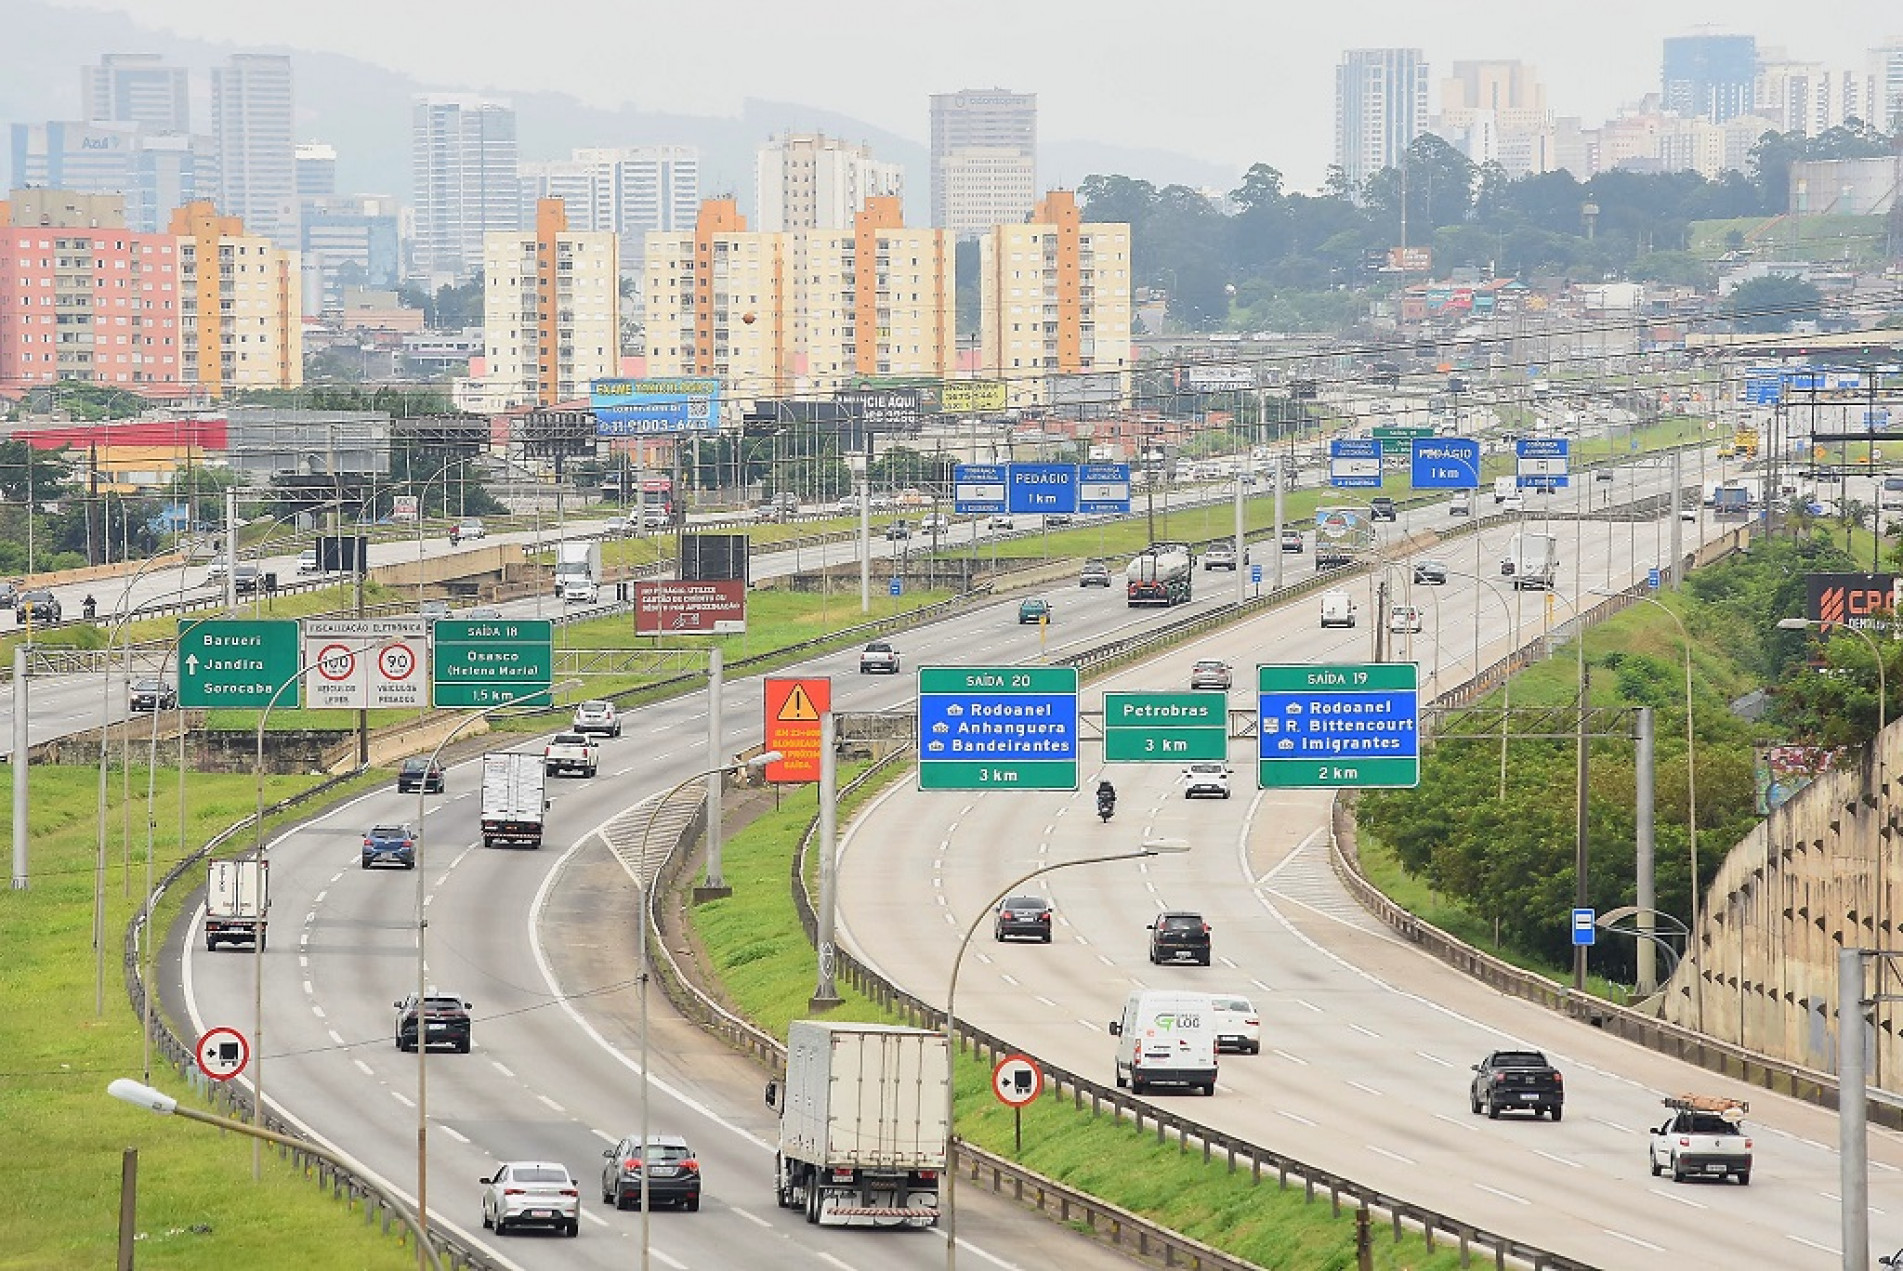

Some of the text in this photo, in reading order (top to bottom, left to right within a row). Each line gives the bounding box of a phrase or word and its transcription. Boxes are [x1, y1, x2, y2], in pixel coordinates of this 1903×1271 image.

[81, 136, 109, 149] Azul
[888, 395, 915, 408] AQUI
[1419, 444, 1473, 460] PEDÁGIO
[1015, 469, 1068, 484] PEDÁGIO
[1438, 468, 1460, 479] km
[1036, 493, 1057, 504] km
[310, 623, 421, 633] FISCALIZAÇÃO ELETRÔNICA
[467, 623, 518, 637] SAÍDA 18
[203, 635, 261, 646] Barueri
[387, 654, 408, 668] 90
[467, 650, 520, 662] Osasco
[203, 659, 264, 670] Jandira
[447, 665, 538, 676] (Helena Maria)
[966, 672, 1030, 687] SAÍDA 20
[1307, 670, 1368, 685] SAÍDA 19
[203, 683, 273, 694] Sorocaba
[376, 683, 417, 692] VEÍCULOS
[491, 690, 514, 701] km
[971, 703, 1051, 716] Rodoanel
[1123, 703, 1209, 717] Petrobras
[1309, 700, 1391, 714] Rodoanel
[958, 722, 1066, 736] Anhanguera
[1285, 720, 1301, 732] R.
[1309, 718, 1413, 732] Bittencourt
[952, 739, 1070, 752] Bandeirantes
[1145, 739, 1187, 752] 3 km
[1302, 737, 1400, 753] Imigrantes
[979, 769, 1018, 781] 3 km
[1318, 767, 1358, 779] 2 km
[1177, 1017, 1200, 1028] LOG
